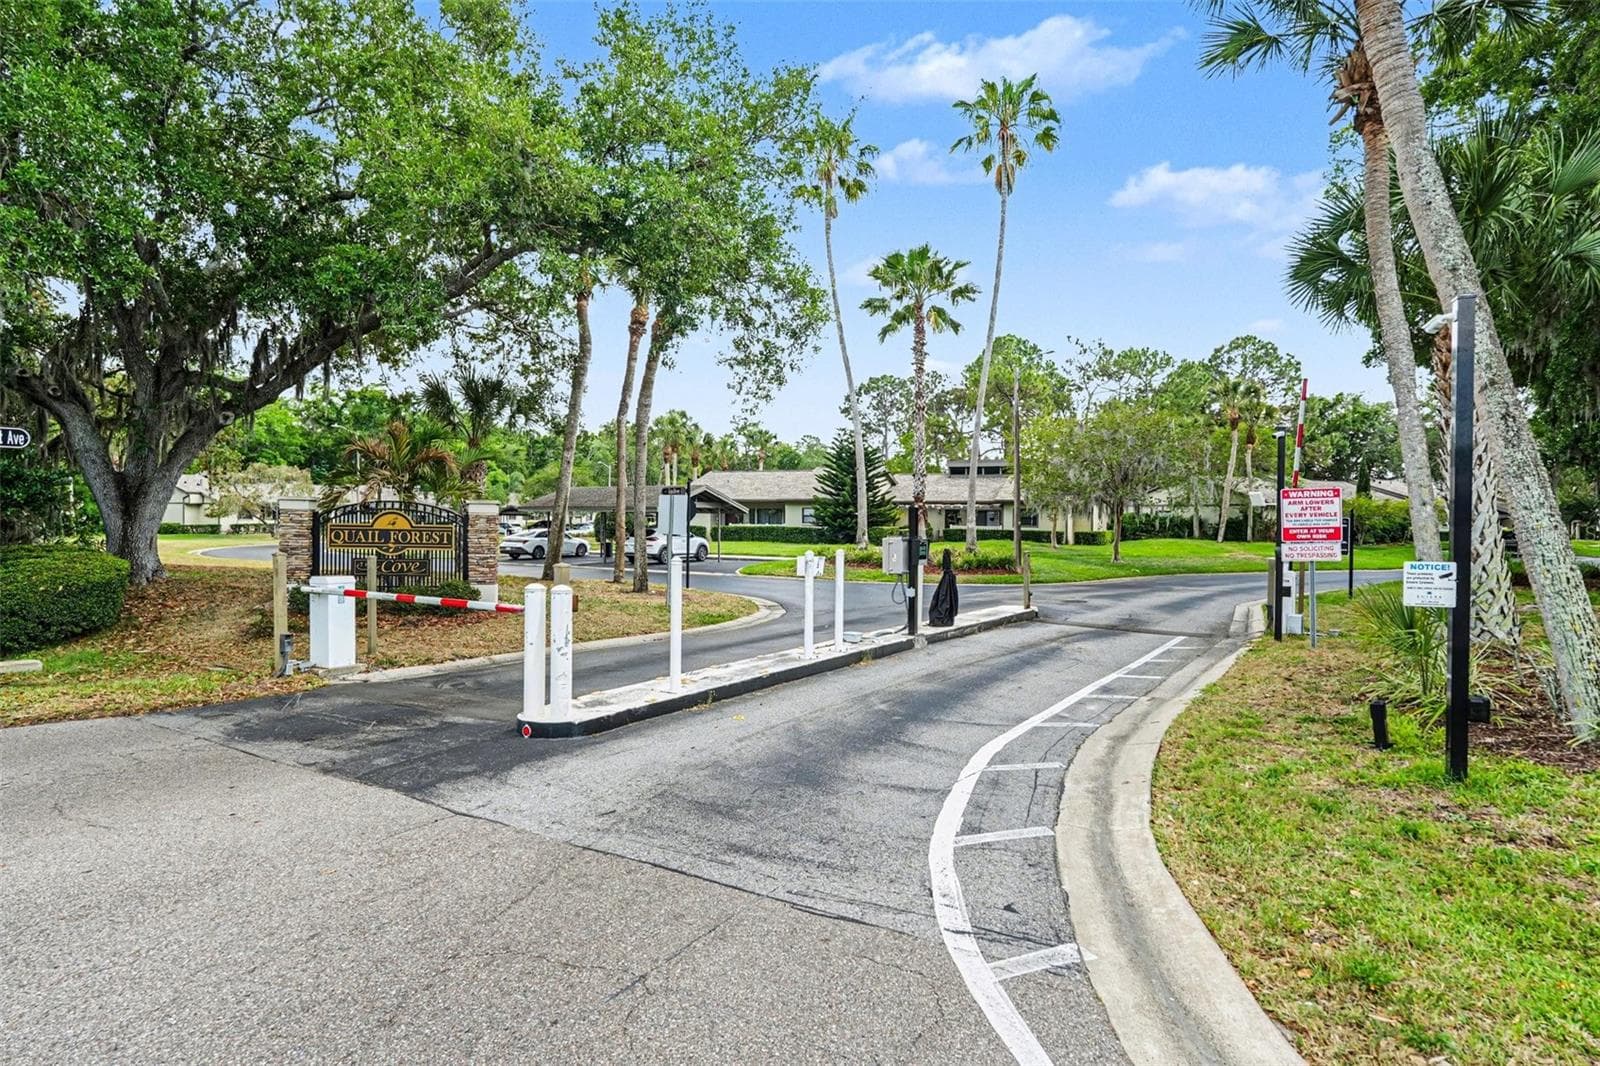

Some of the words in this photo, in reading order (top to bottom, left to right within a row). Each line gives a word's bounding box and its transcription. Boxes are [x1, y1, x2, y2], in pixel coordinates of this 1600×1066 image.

[7, 430, 25, 445] Ave
[1288, 490, 1334, 498] WARNING
[330, 529, 385, 544] QUAIL
[389, 530, 452, 544] FOREST
[381, 559, 426, 573] Cove
[1410, 563, 1451, 571] NOTICE!
